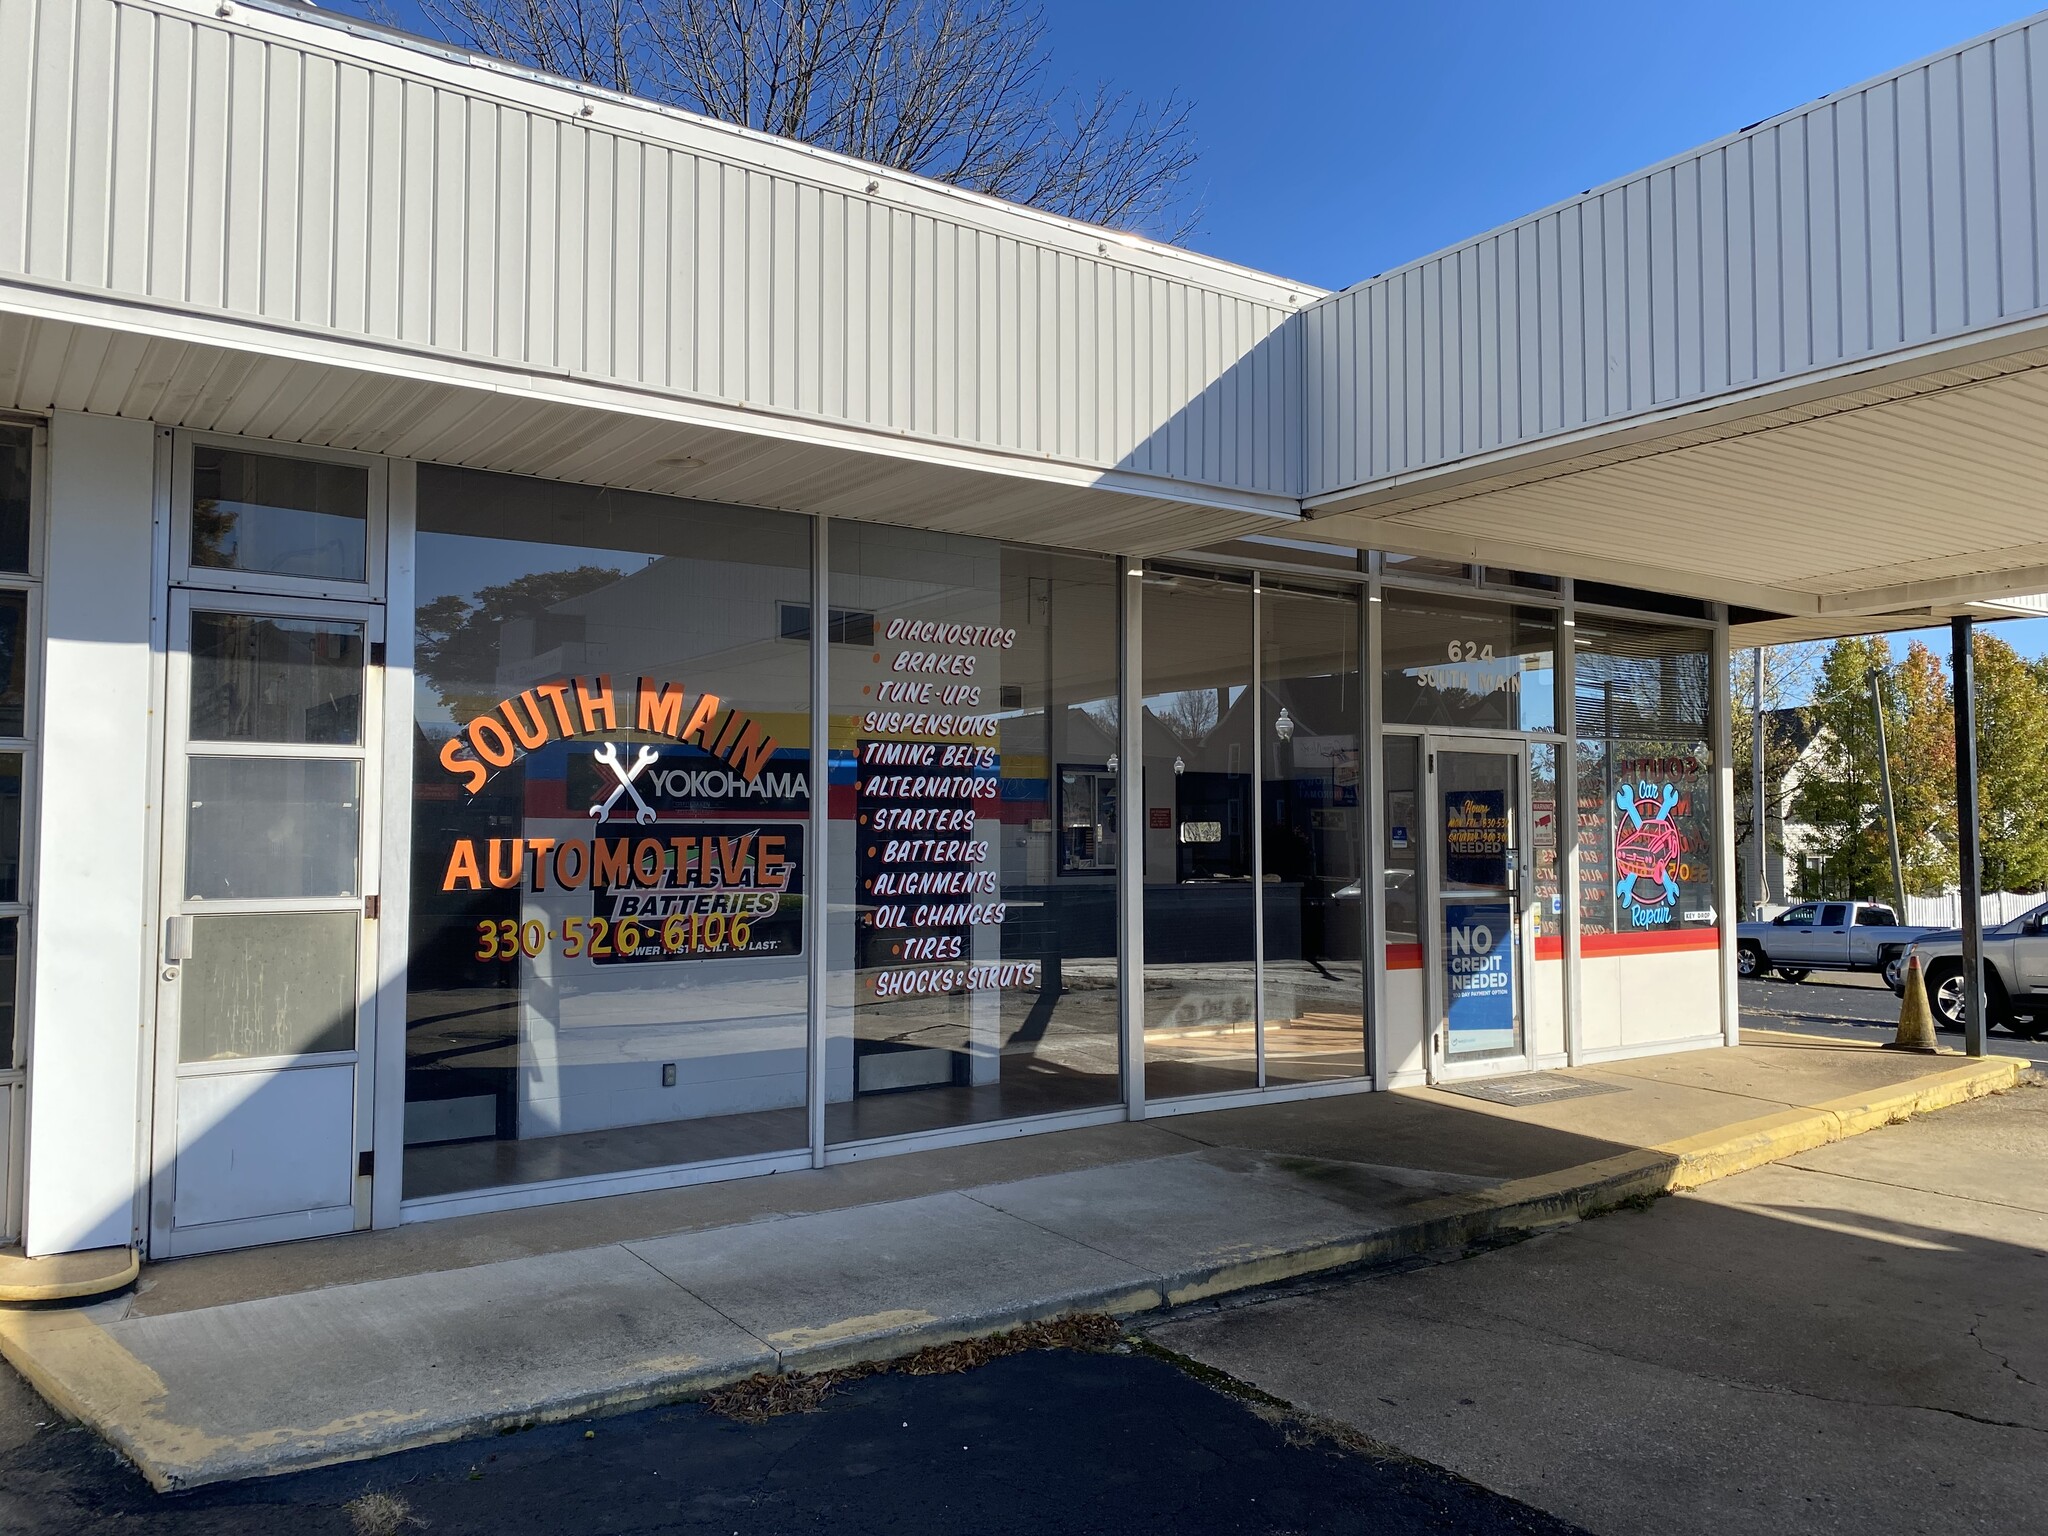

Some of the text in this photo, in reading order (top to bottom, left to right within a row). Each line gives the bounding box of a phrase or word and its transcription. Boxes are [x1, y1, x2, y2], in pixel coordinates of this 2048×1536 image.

[886, 618, 1016, 649] DIAGNOSTICS
[893, 651, 976, 676] BRAKES
[1448, 640, 1495, 664] 624
[1417, 667, 1521, 693] SOUTH MAIN
[876, 680, 981, 707] TUNE-UPS
[438, 674, 780, 795] SOUTH MAIN
[863, 711, 998, 737] SUSPENSIONS
[863, 743, 996, 769] TIMING BELTS
[648, 769, 809, 798] YOKOHAMA
[864, 776, 997, 799] ALTERNATORS
[1638, 780, 1659, 799] Car
[873, 809, 976, 832] STARTERS
[883, 840, 988, 864] BATTERIES
[1450, 842, 1501, 853] NEEDED
[437, 835, 786, 893] AUTOMOTIVE
[873, 871, 996, 896] ALIGNMENTS
[619, 893, 774, 917] BATTERIES
[874, 902, 1006, 929] OIL CHANGES
[1631, 901, 1672, 930] Repair
[902, 936, 962, 960] TIRES
[1451, 925, 1492, 955] NO
[1452, 956, 1502, 973] CREDIT
[876, 968, 954, 997] SHOCKS
[966, 963, 1035, 991] STRUTS
[1452, 972, 1508, 991] NEEDED
